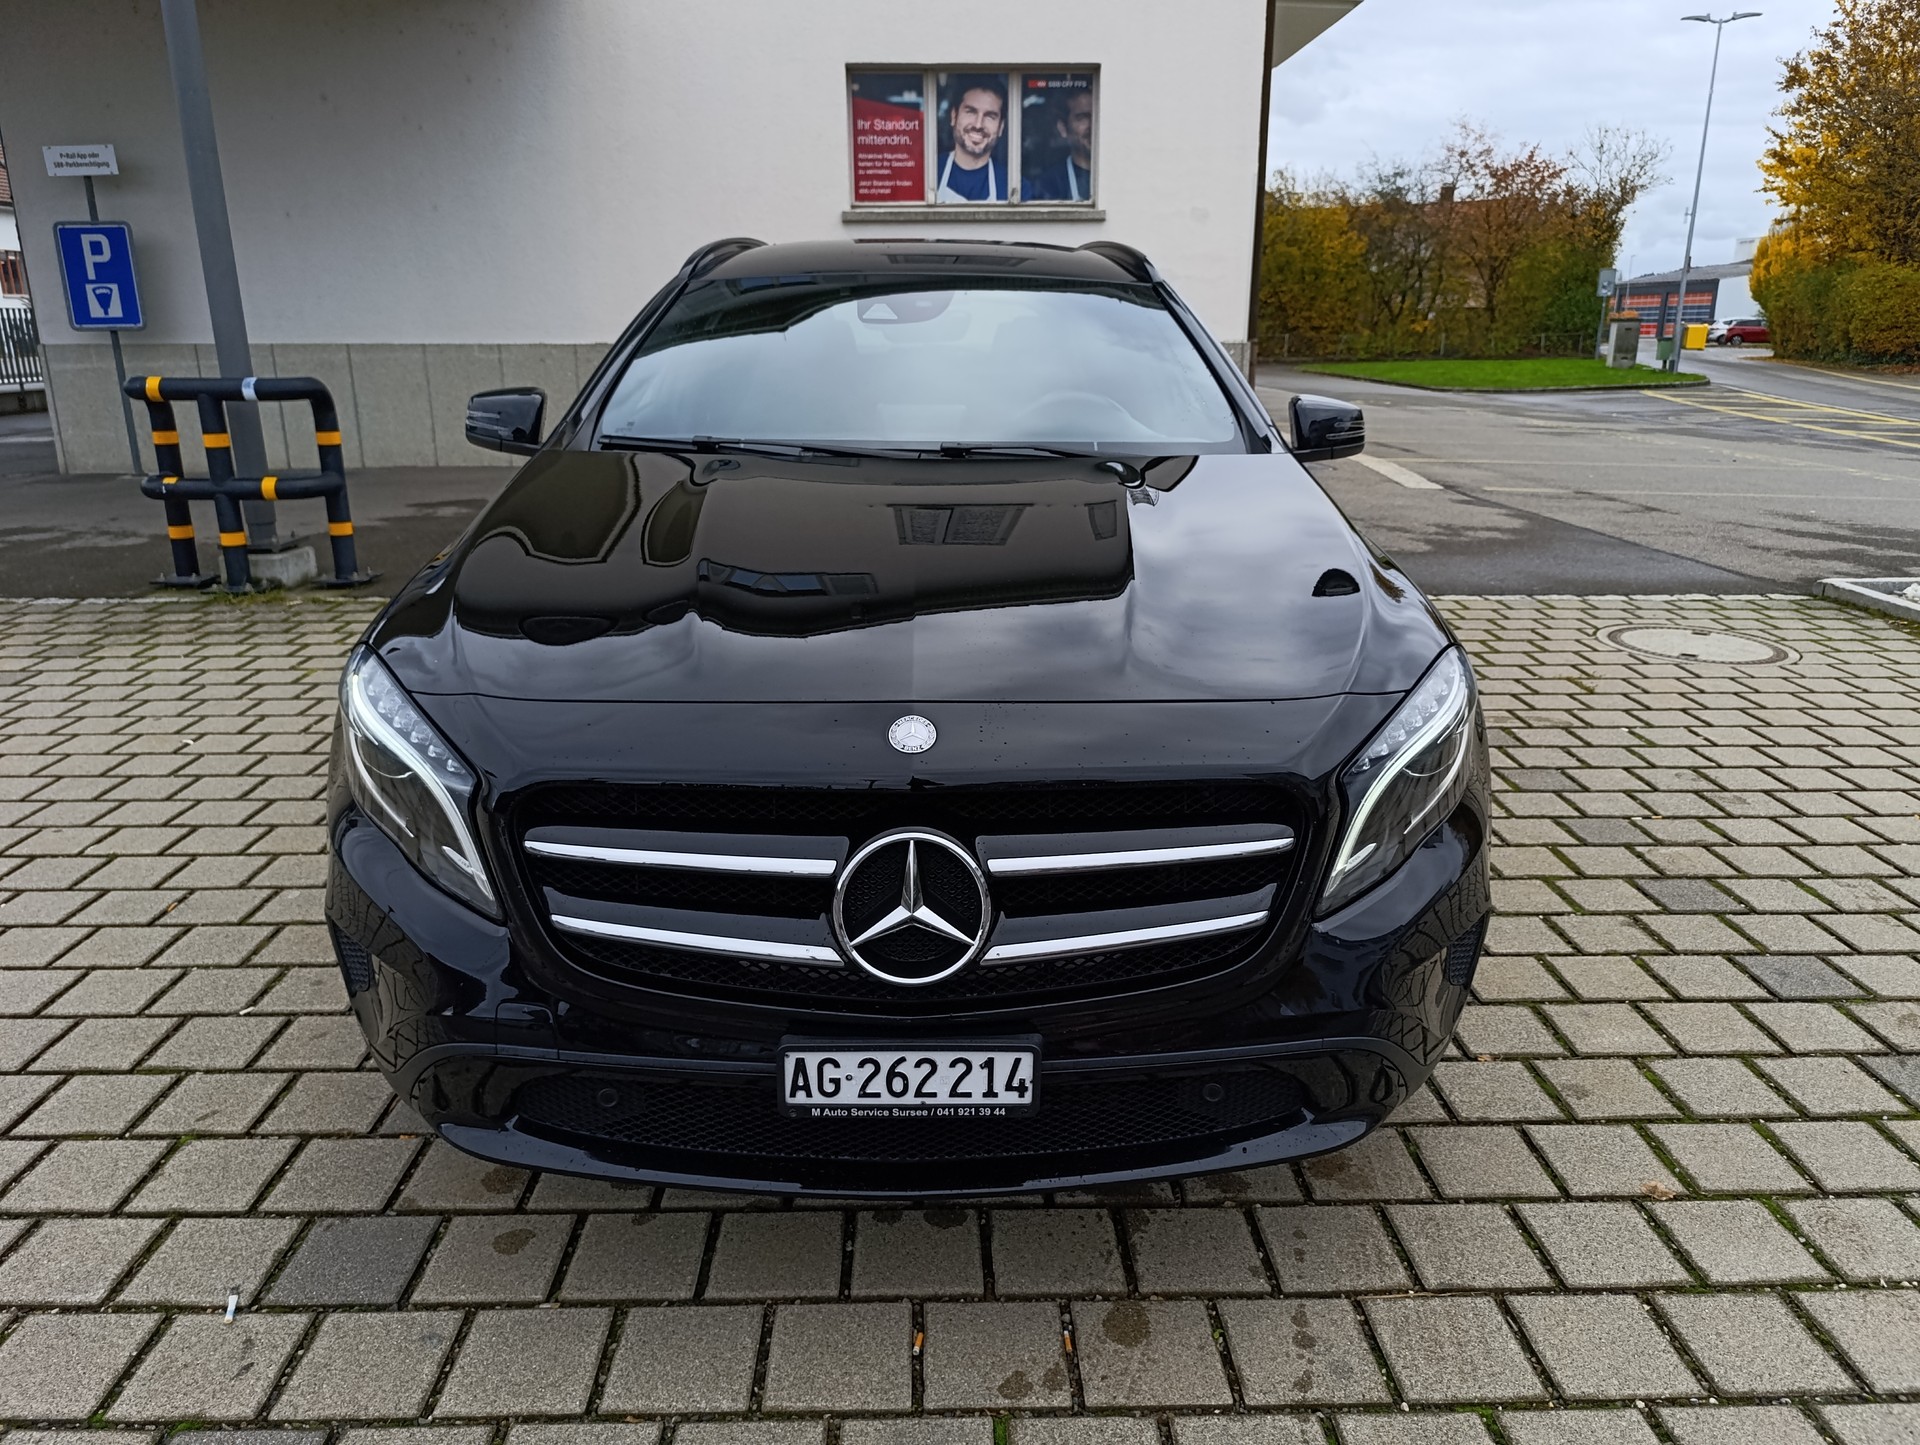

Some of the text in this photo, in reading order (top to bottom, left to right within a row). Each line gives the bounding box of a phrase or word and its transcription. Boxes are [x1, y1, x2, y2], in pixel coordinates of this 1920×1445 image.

[857, 119, 919, 130] Ihr Standort
[857, 134, 912, 146] mittendrin.
[77, 152, 87, 160] App
[81, 234, 111, 280] P
[811, 1108, 821, 1117] M
[823, 1108, 848, 1117] Auto
[850, 1107, 890, 1117] Service
[892, 1108, 928, 1117] Sursee
[936, 1108, 954, 1117] 041
[957, 1107, 975, 1117] 921
[978, 1107, 991, 1116] 39
[993, 1107, 1006, 1116] 44
